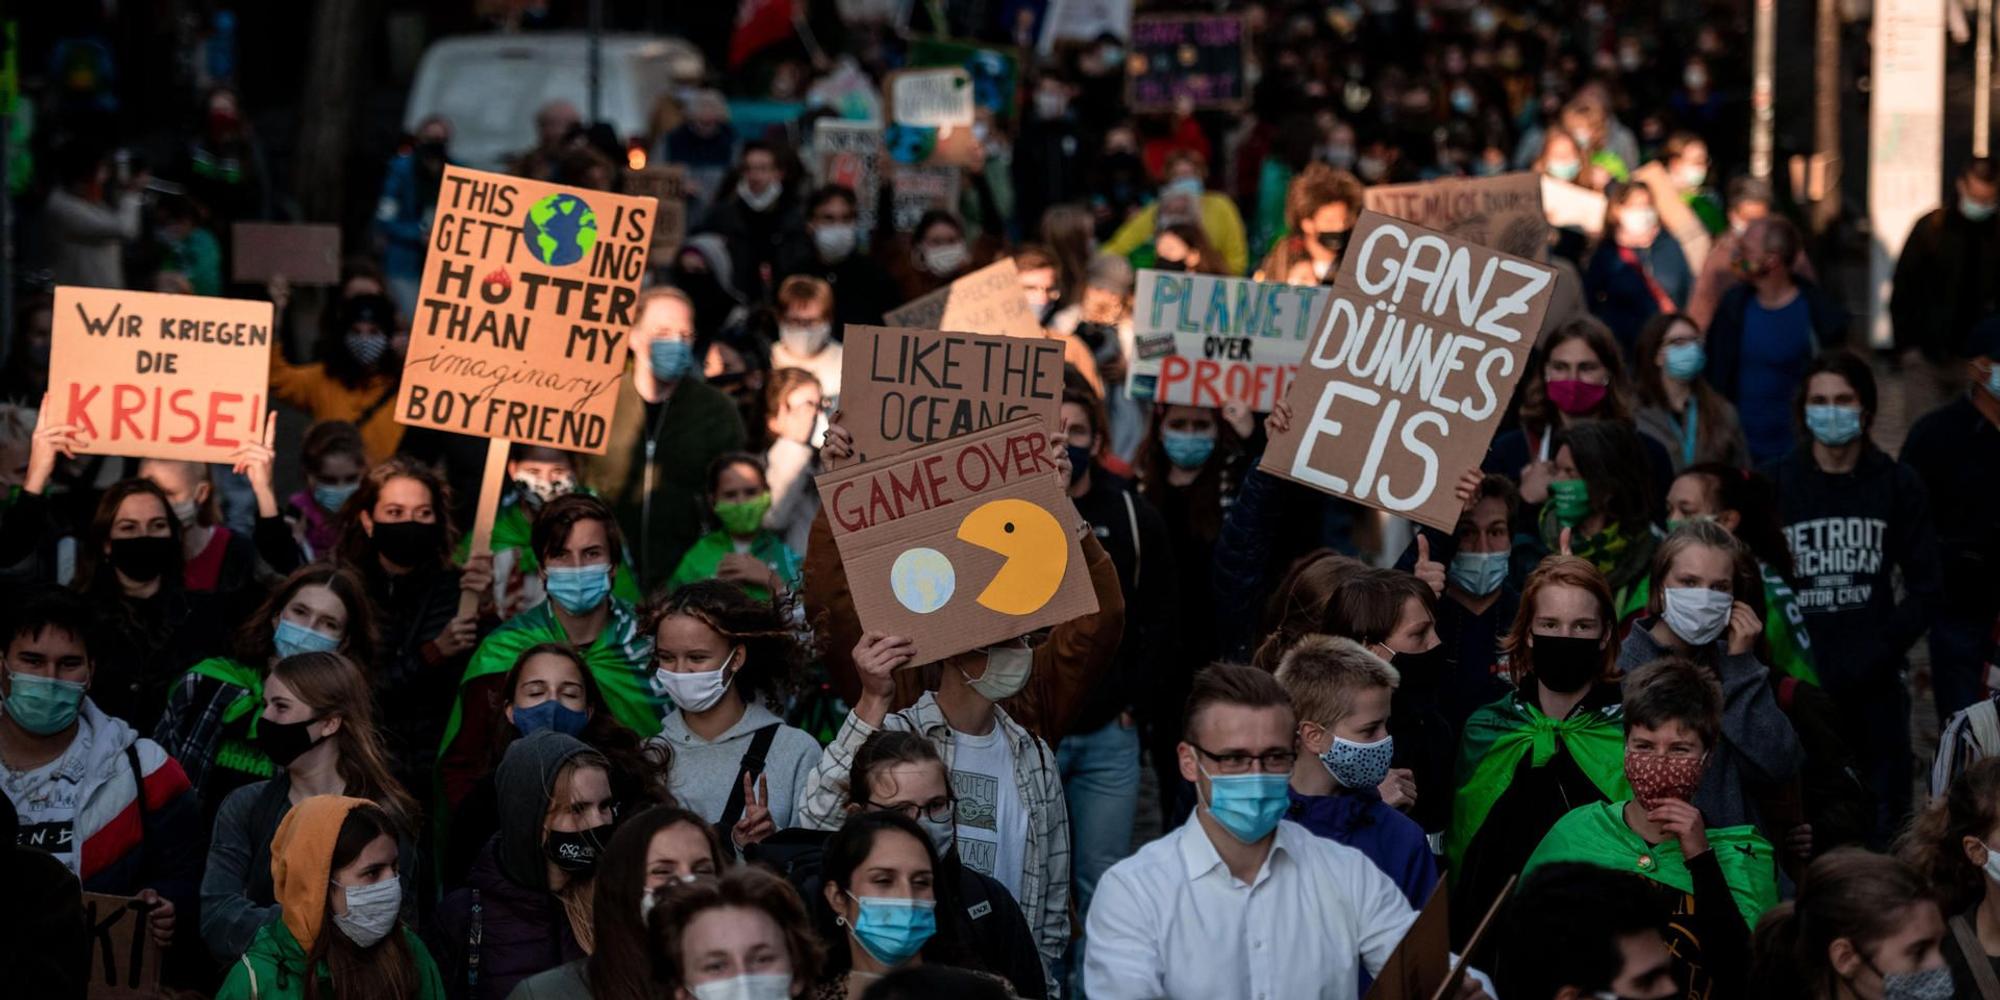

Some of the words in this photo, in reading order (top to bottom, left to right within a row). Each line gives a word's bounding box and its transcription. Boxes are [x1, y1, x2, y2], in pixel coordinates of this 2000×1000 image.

[447, 175, 519, 218] THIS
[610, 206, 647, 243] IS
[436, 259, 637, 326] HOTTER
[1152, 275, 1320, 341] PLANET
[1356, 224, 1551, 342] GANZ
[136, 350, 178, 374] DIE
[160, 318, 267, 347] KRIEGEN
[424, 299, 531, 351] THAN
[565, 324, 625, 365] MY
[1204, 336, 1254, 362] OVER
[1311, 298, 1514, 421] DÜNNES
[404, 345, 625, 414] imaginary
[871, 334, 966, 390] LIKE
[974, 340, 1059, 400] THE
[65, 382, 260, 448] KRISE!
[406, 384, 606, 449] BOYFRIEND
[1291, 380, 1449, 512] EIS
[831, 456, 954, 532] GAME
[956, 432, 1056, 492] OVER
